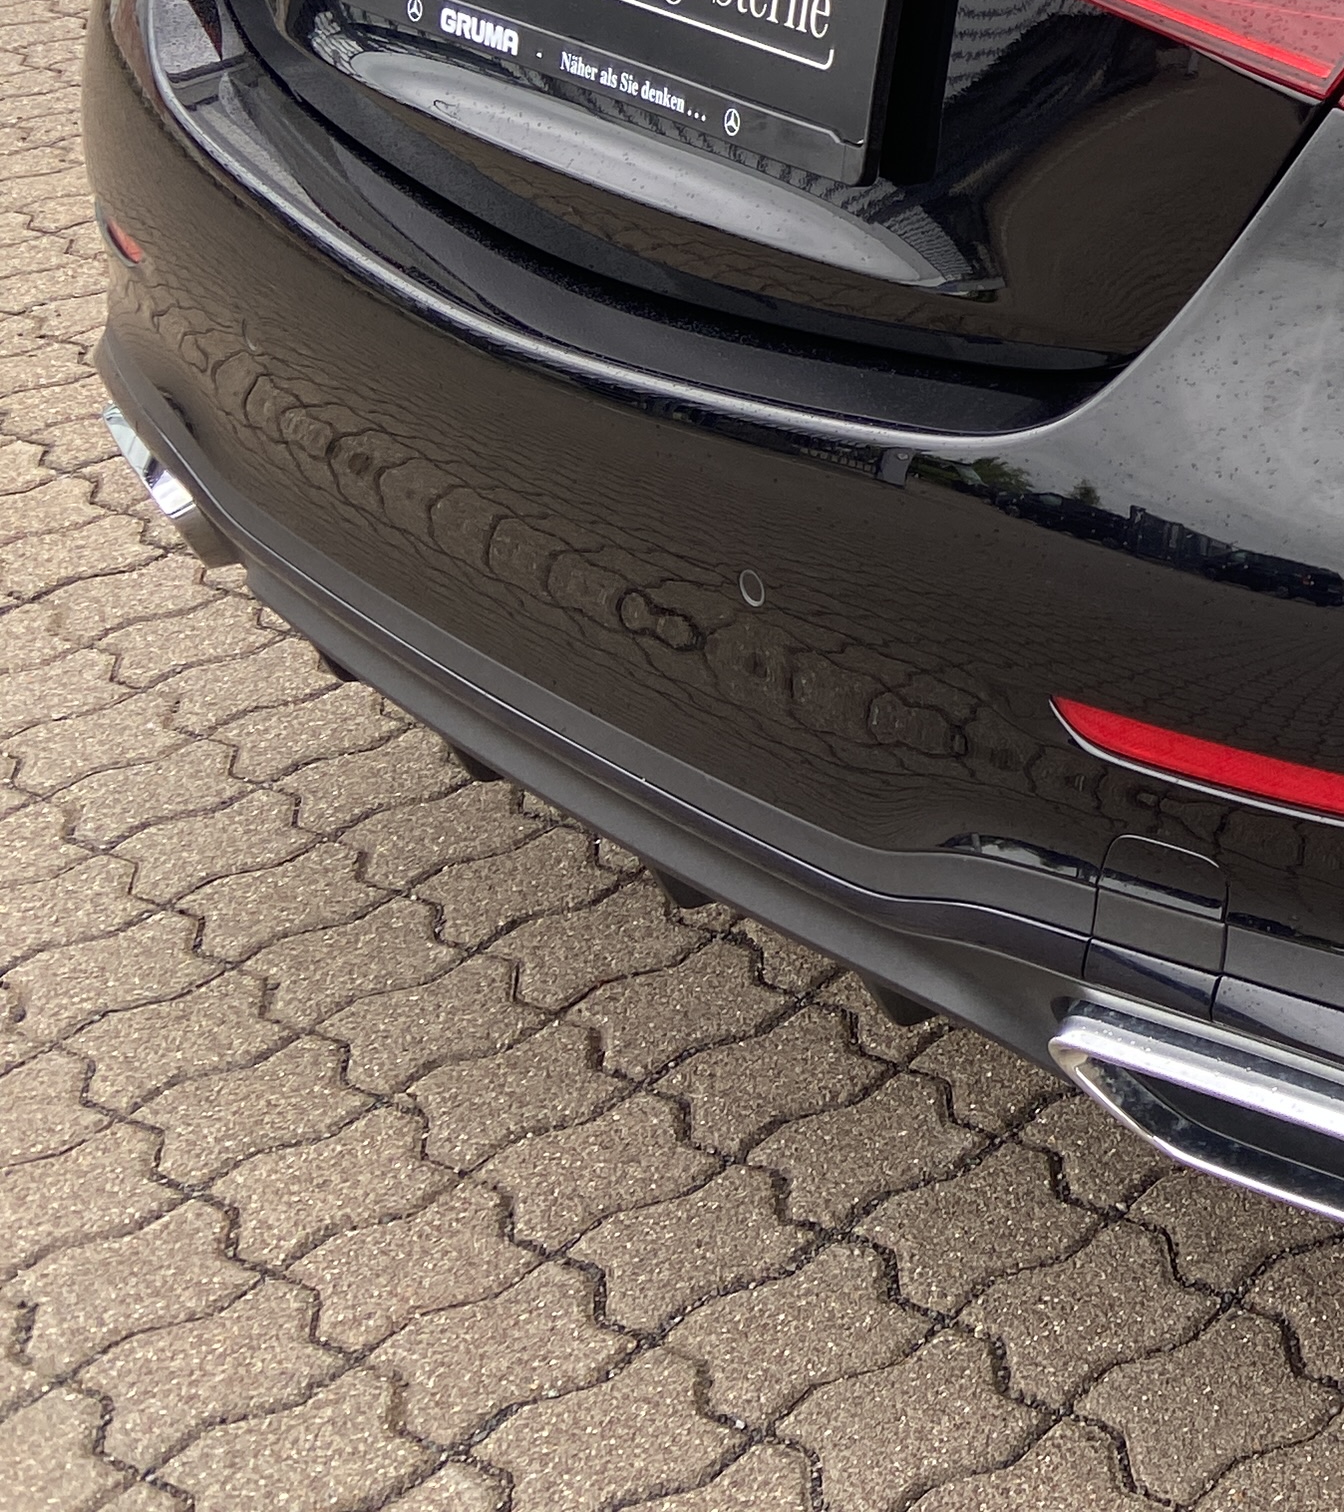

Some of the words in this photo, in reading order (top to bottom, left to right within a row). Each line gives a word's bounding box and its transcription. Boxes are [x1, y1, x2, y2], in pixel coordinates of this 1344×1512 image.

[440, 7, 519, 56] GRUMA
[559, 51, 599, 81] Näher
[600, 67, 619, 90] als
[619, 72, 639, 97] Sie
